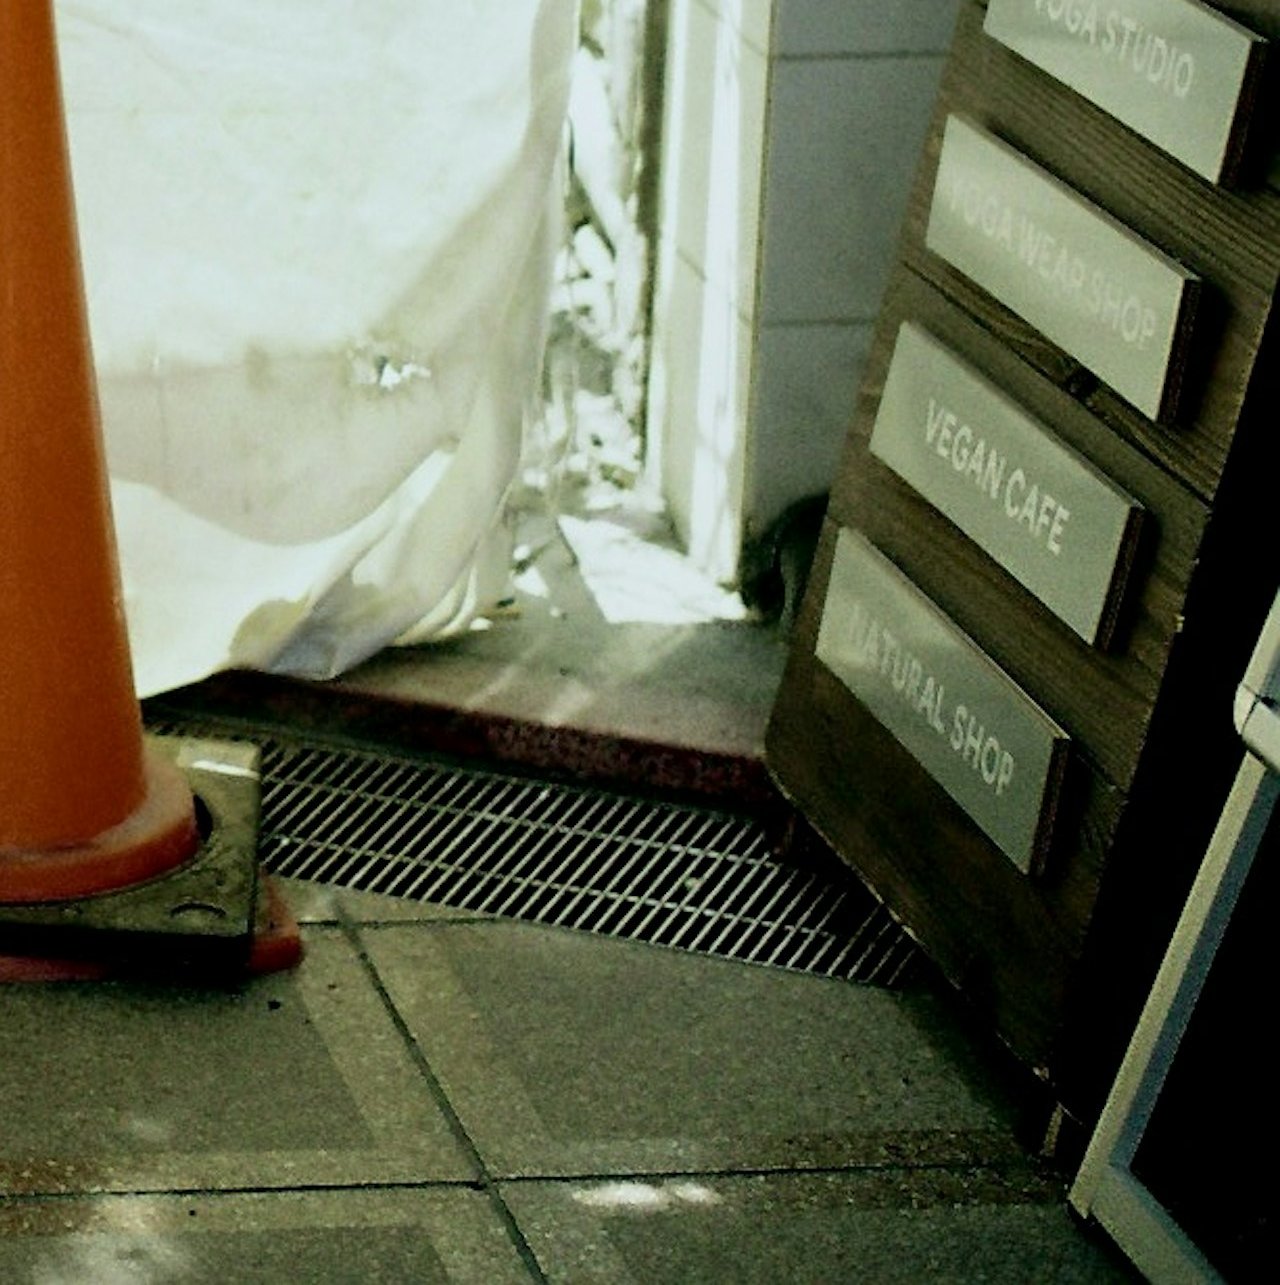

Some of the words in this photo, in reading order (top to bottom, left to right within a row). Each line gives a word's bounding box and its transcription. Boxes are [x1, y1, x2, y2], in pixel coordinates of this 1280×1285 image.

[1102, 9, 1194, 97] STUDIO
[1090, 270, 1157, 351] SHOP
[925, 398, 1007, 500] VEGAN
[1005, 467, 1070, 557] CAFE
[849, 604, 946, 734] NATURAL
[950, 705, 1015, 795] SHOP
